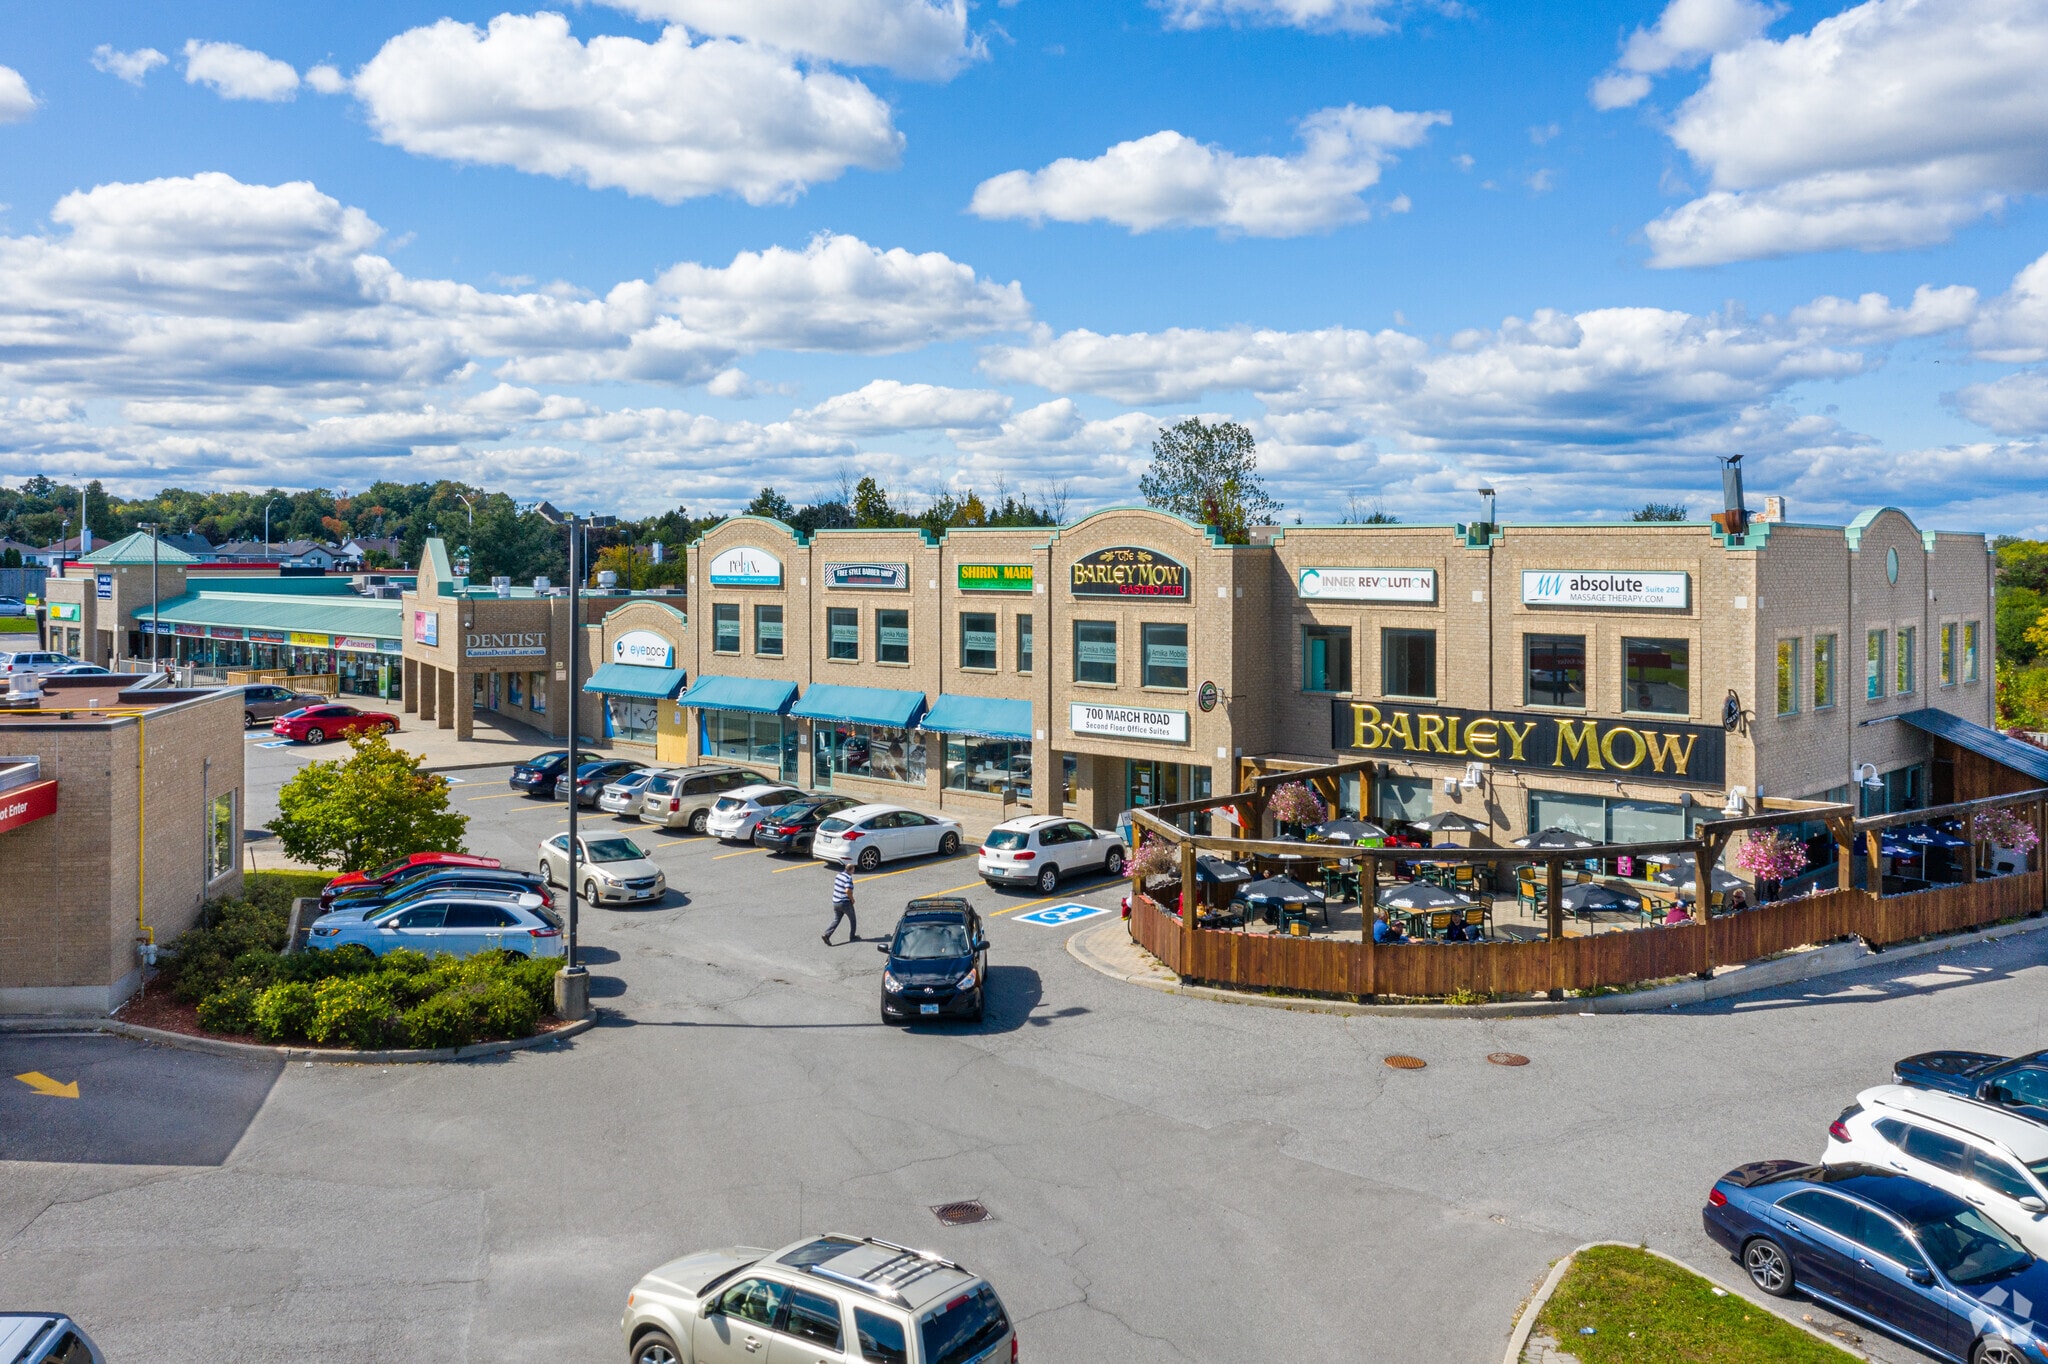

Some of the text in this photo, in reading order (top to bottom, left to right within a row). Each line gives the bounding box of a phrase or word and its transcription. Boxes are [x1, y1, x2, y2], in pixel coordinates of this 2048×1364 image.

[961, 565, 998, 579] SHIRIN
[1074, 563, 1182, 586] BARLEY MOW
[1322, 576, 1355, 587] INNER
[1570, 575, 1642, 592] absolute
[1119, 585, 1183, 596] GASTRO PUB
[1645, 586, 1680, 594] Suite 202
[1570, 593, 1606, 602] MASSAGE
[345, 639, 376, 649] Cleaners
[465, 632, 547, 648] DENTIST
[467, 648, 545, 656] KanataDentalCare.com
[1085, 707, 1170, 726] 700 MARCH ROAD
[1085, 721, 1170, 736] Second Floor Office Suites
[1350, 702, 1699, 776] BARLEY MOW
[9, 802, 28, 818] Enter
